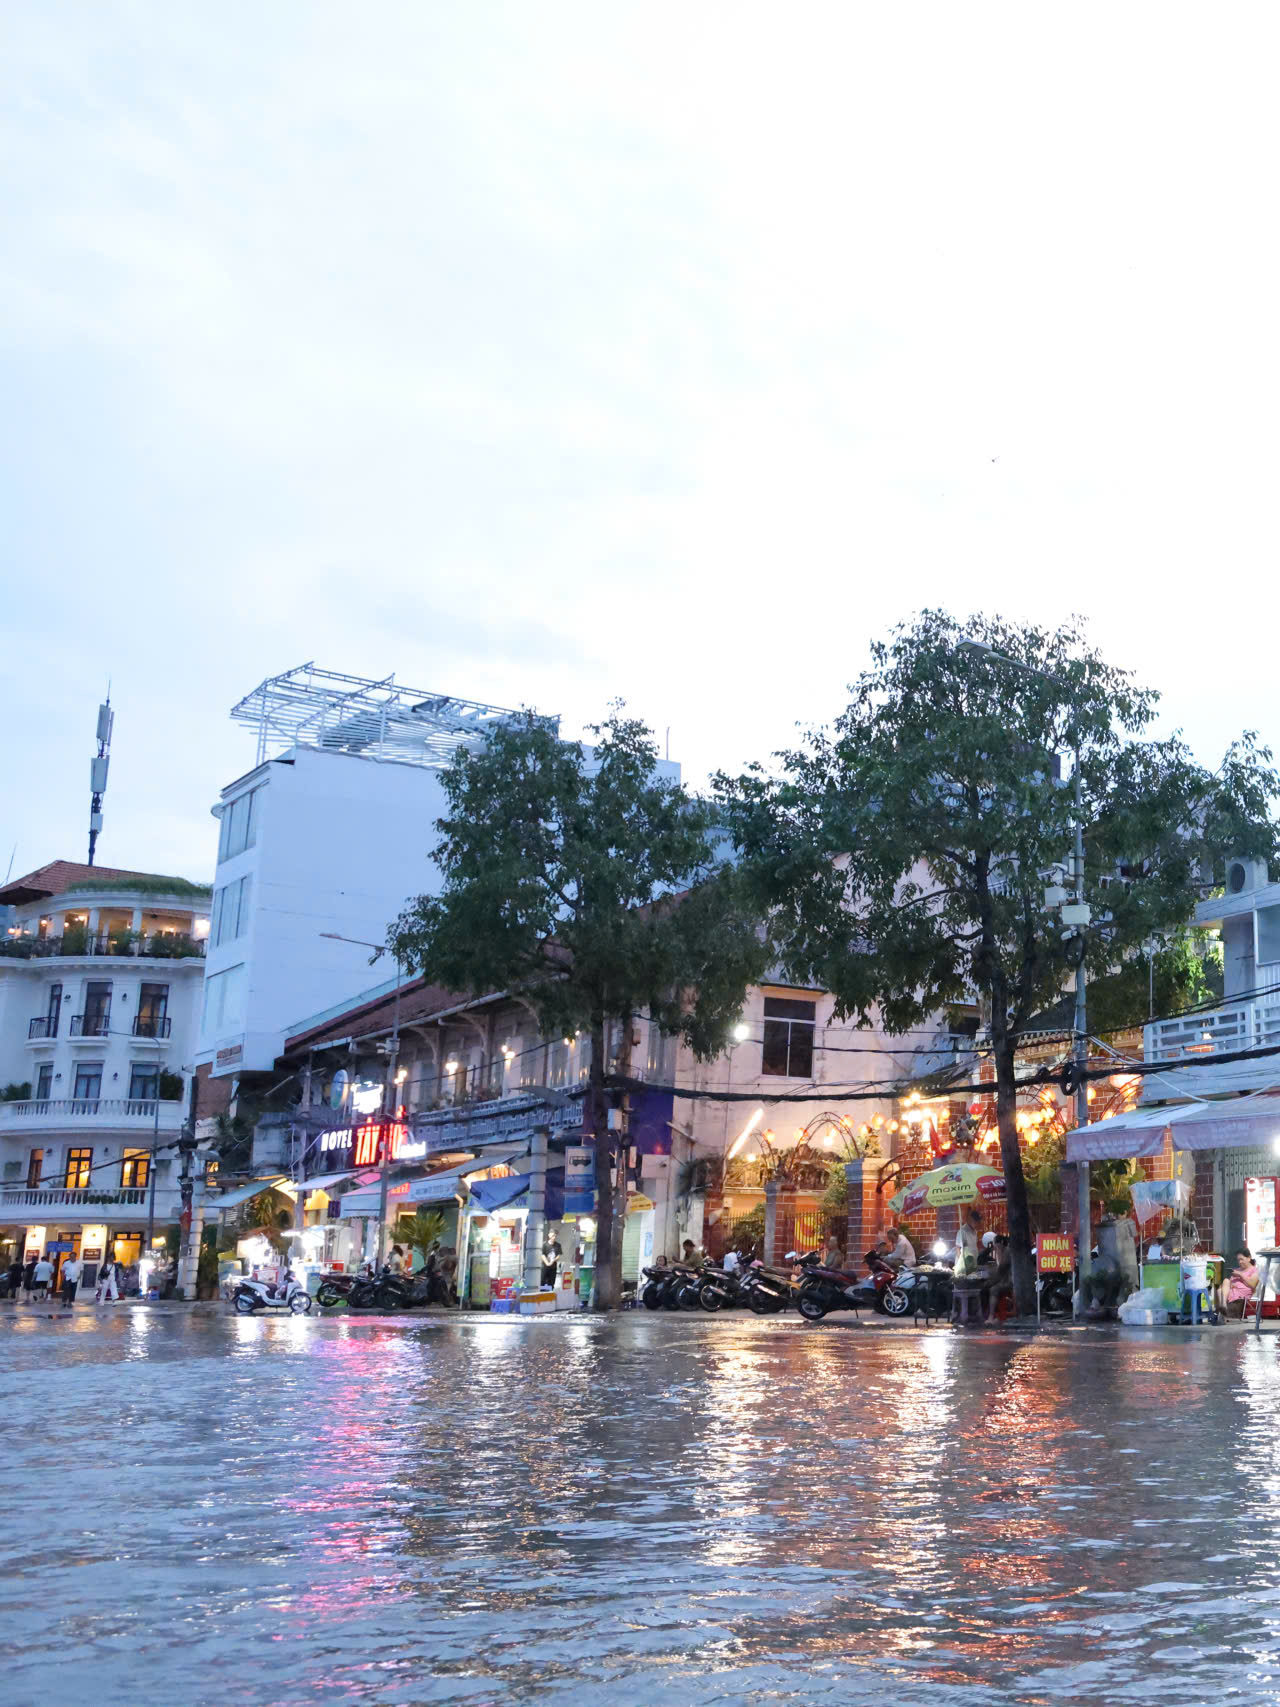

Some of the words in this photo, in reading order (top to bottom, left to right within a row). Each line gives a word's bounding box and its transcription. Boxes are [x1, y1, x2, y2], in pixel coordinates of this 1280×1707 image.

[321, 1129, 353, 1152] HOTEL
[354, 1116, 381, 1166] TÂY
[932, 1183, 971, 1195] maxim
[1042, 1237, 1070, 1252] NHẬN
[1041, 1255, 1058, 1269] GIỮ
[1059, 1255, 1071, 1269] XE
